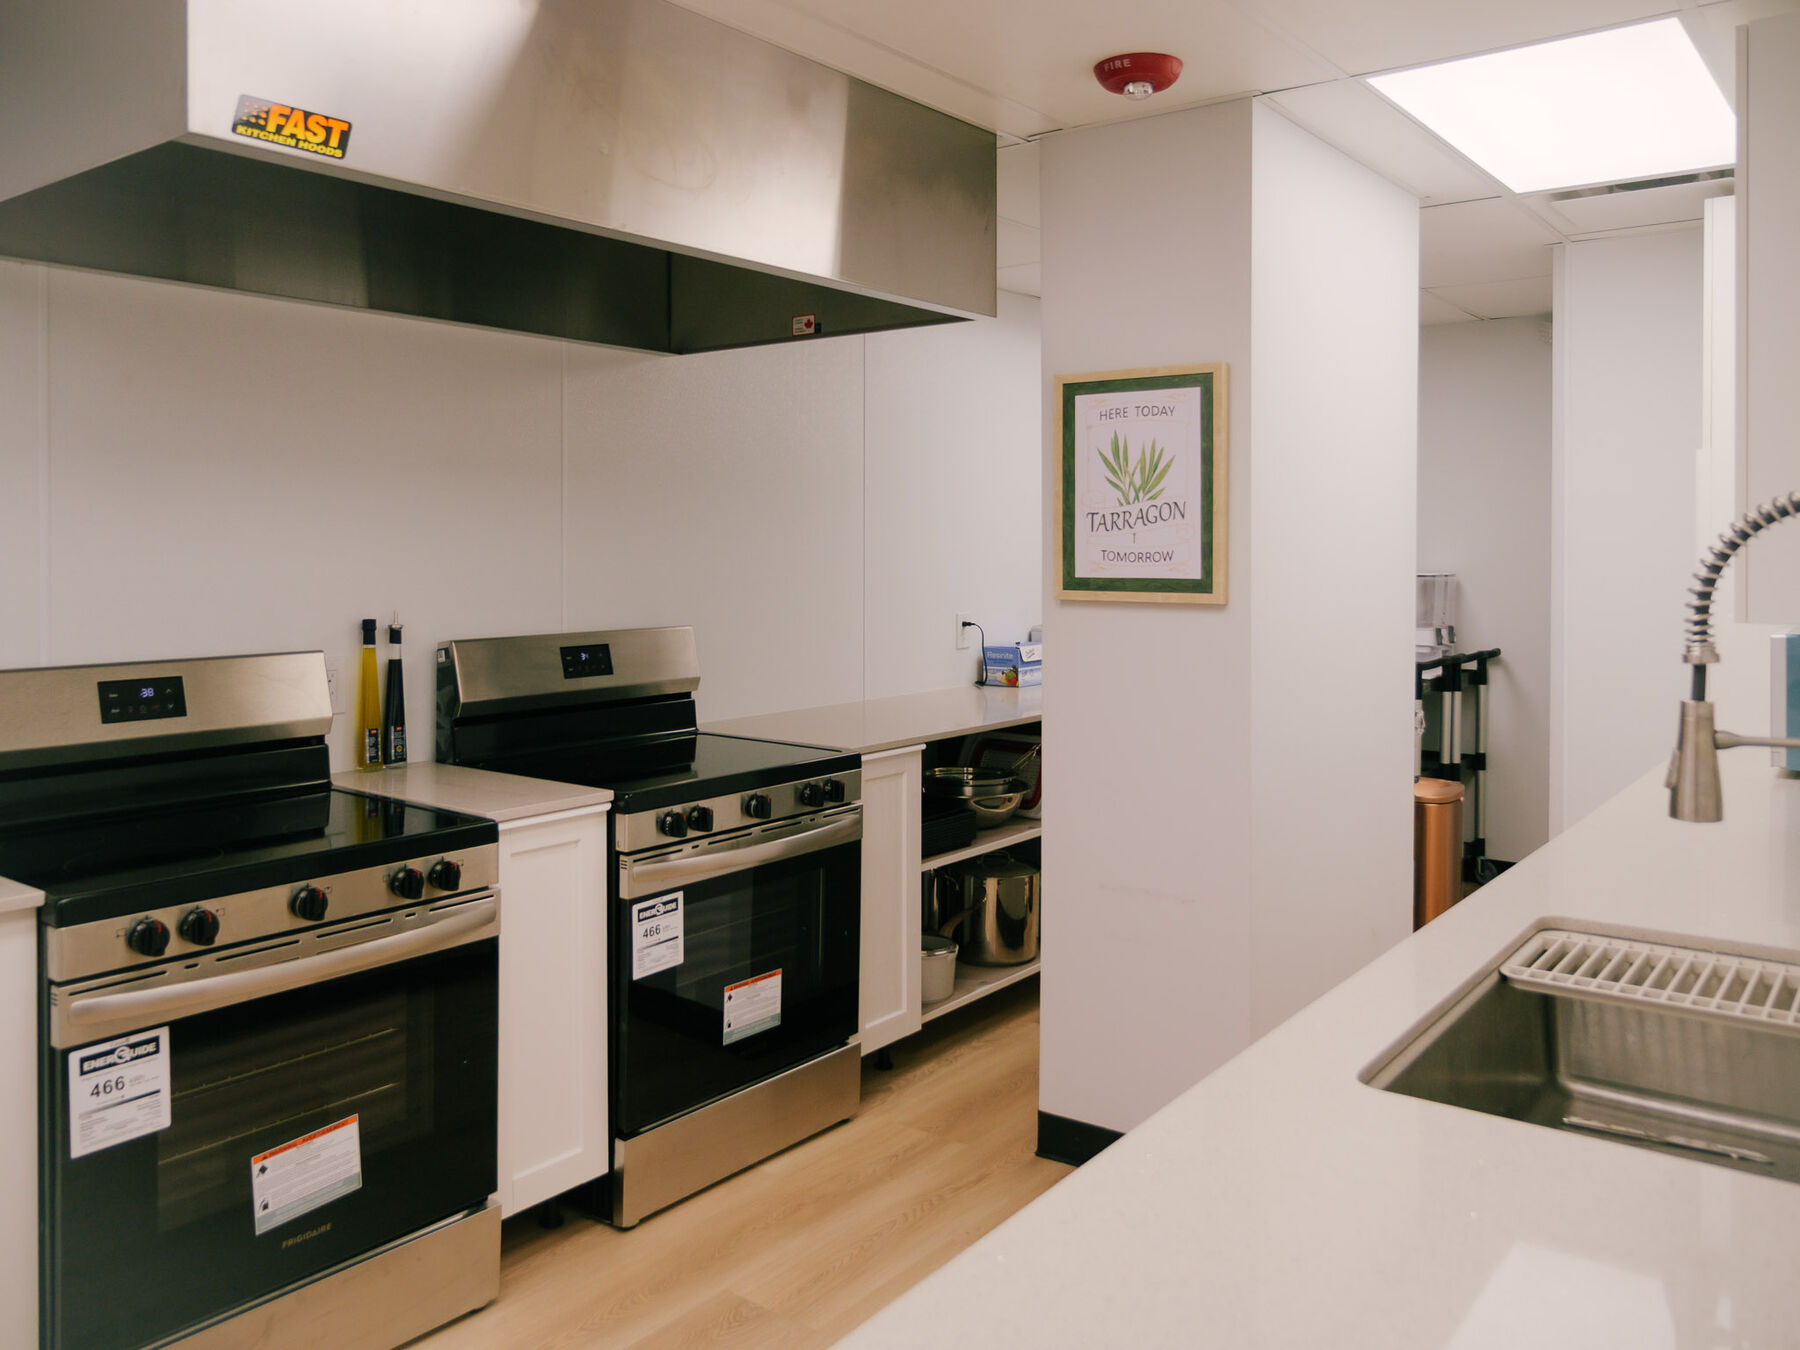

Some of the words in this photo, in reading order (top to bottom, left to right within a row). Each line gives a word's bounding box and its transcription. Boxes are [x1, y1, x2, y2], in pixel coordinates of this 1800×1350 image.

[1102, 58, 1132, 73] FIRE
[264, 103, 350, 149] FAST
[235, 124, 297, 147] KITCHEN
[297, 140, 343, 158] HOODS
[1099, 406, 1129, 421] HERE
[1134, 405, 1176, 417] TODAY
[1086, 500, 1187, 533] TARRAGON
[1101, 549, 1175, 563] TOMORROW
[642, 924, 661, 938] 466
[90, 1076, 126, 1097] 466
[281, 1222, 333, 1249] FRIGIDAIRE
